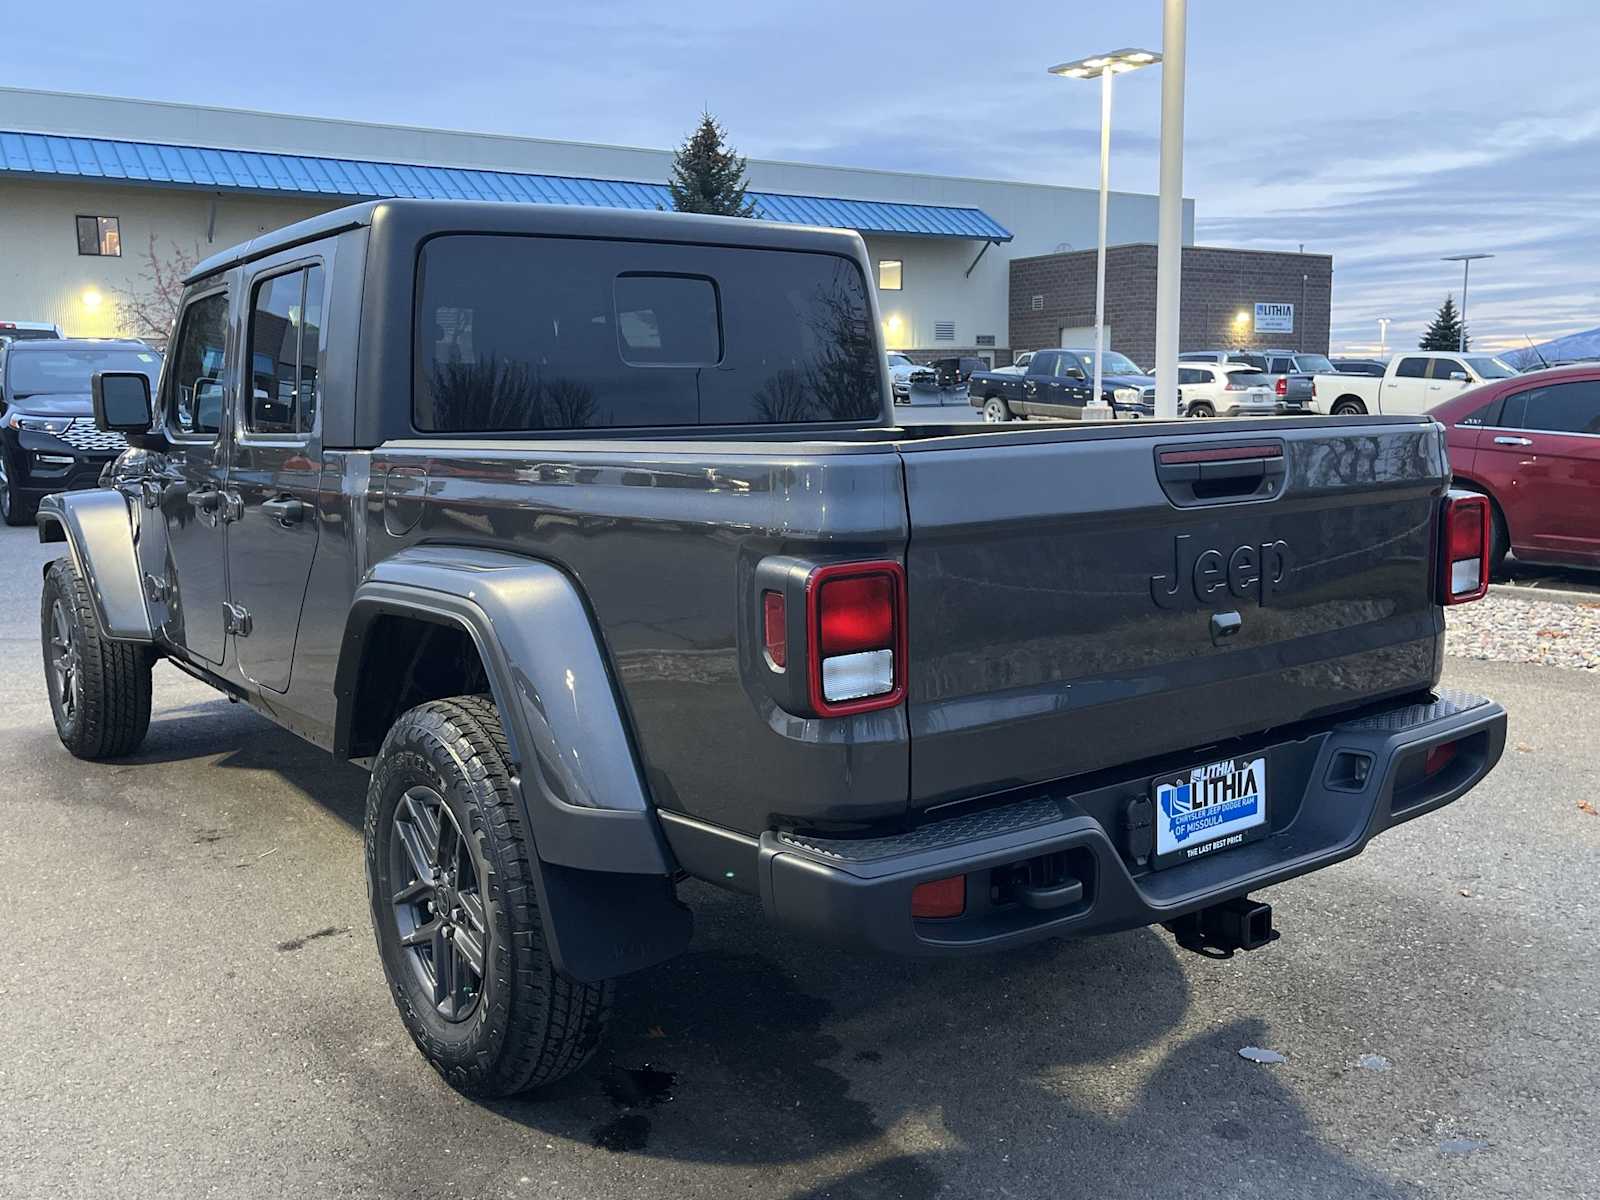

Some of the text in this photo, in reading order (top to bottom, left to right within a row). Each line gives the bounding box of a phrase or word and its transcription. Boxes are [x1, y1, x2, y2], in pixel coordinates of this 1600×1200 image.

[1264, 305, 1291, 316] LITHIA
[1150, 534, 1291, 609] Jeep
[1200, 759, 1235, 780] LITHIA
[1192, 768, 1257, 810] LITHIA
[1175, 797, 1255, 825] CHRYSLER JEEP DODGE RAM
[1175, 815, 1223, 836] OF MISSOULA
[1187, 834, 1243, 857] THE LAST BEST PRICE
